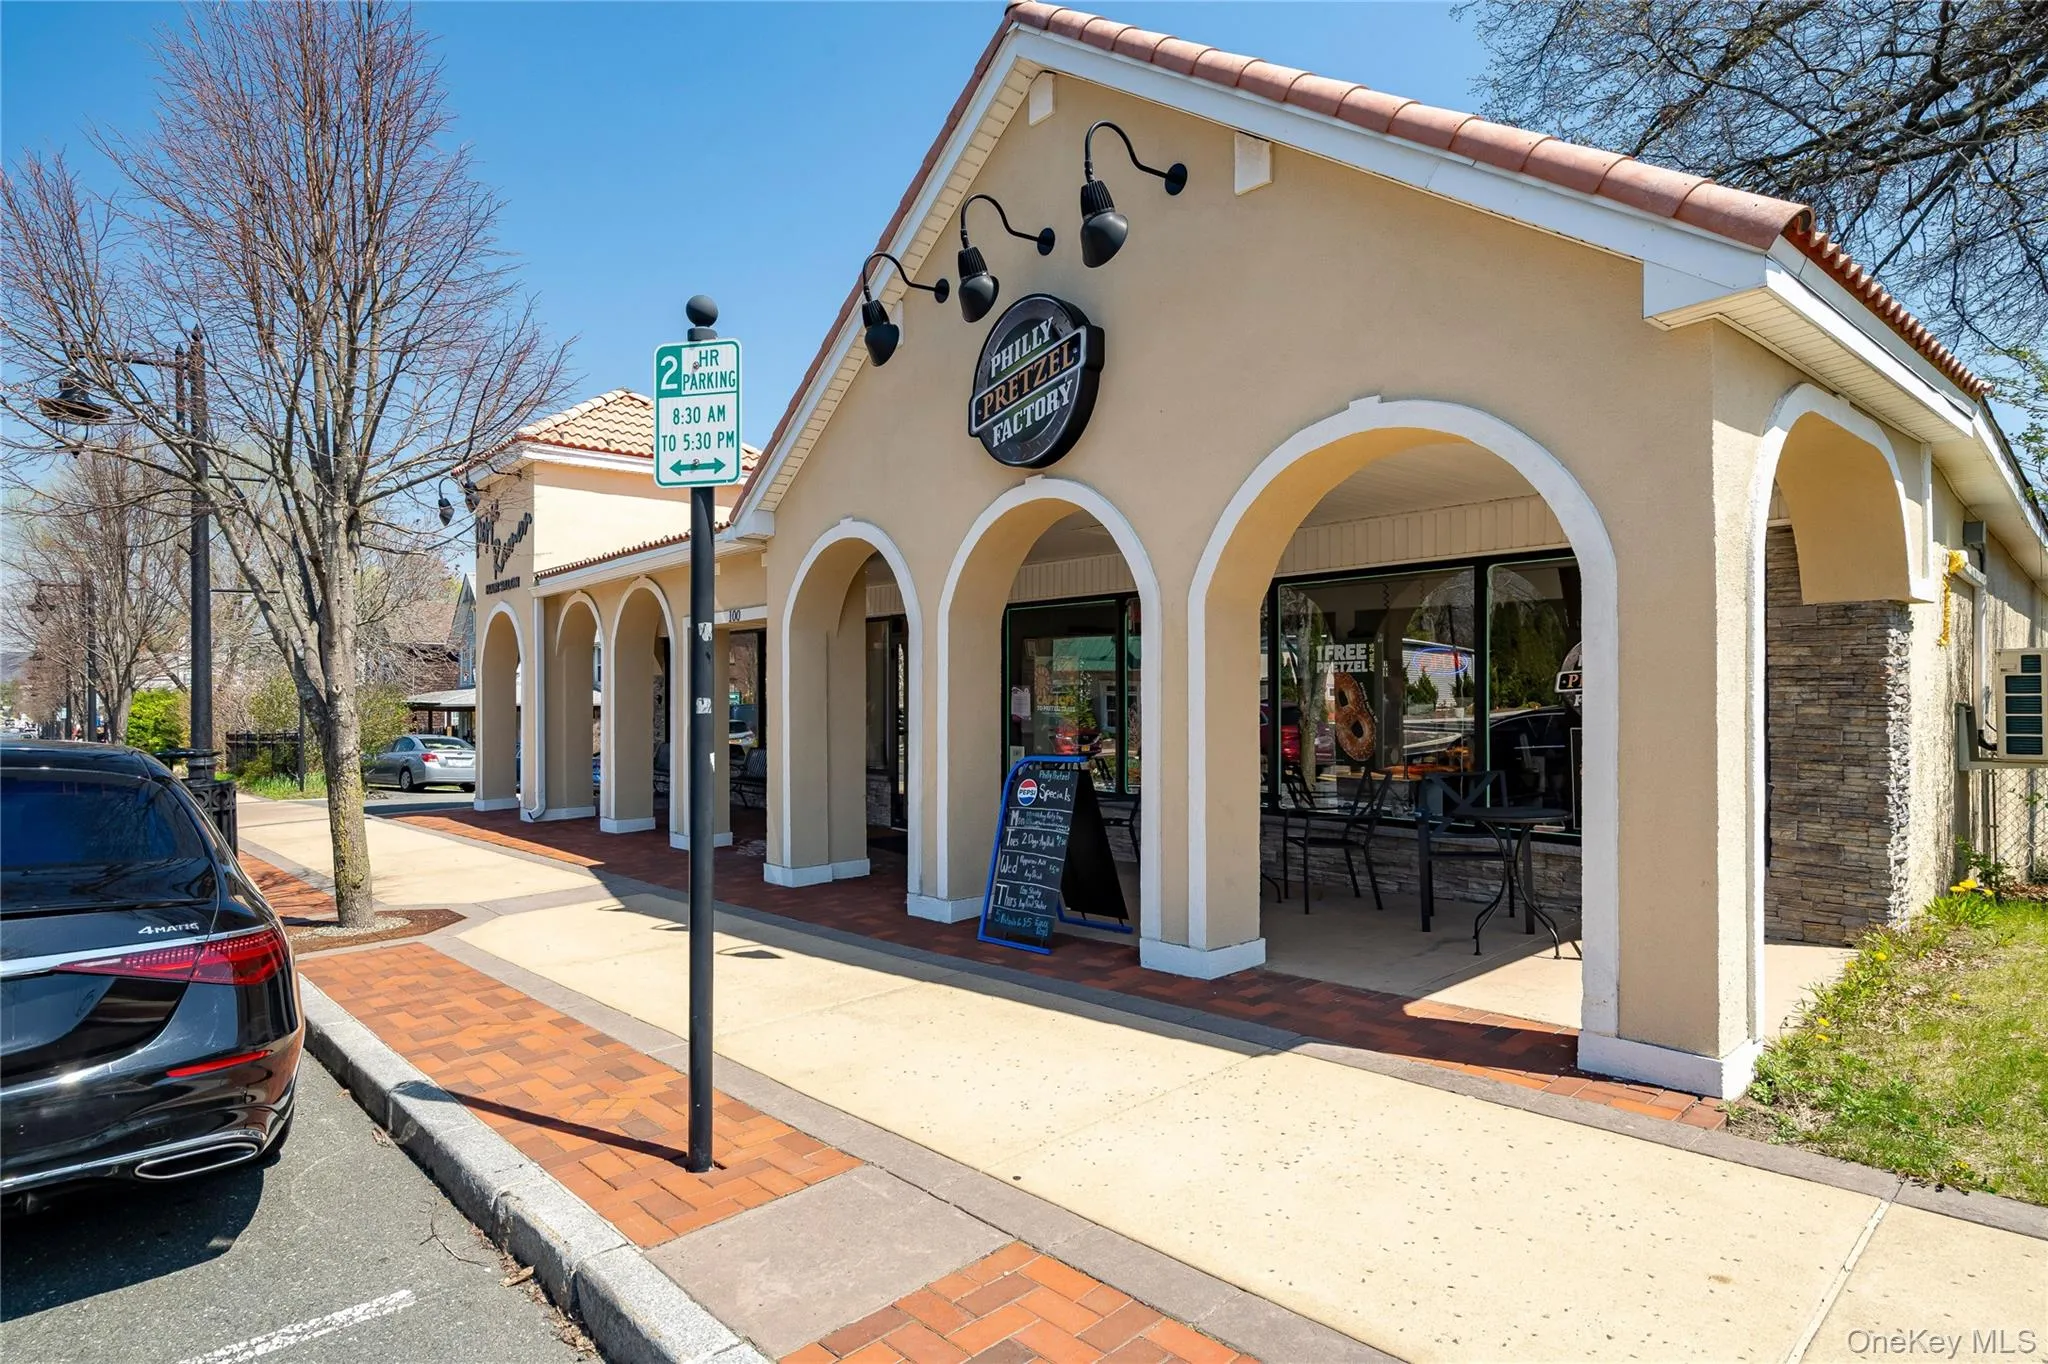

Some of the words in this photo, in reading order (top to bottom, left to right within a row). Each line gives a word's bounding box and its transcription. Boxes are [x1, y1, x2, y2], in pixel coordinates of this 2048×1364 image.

[991, 317, 1053, 378] PHILLY
[660, 355, 678, 390] 2
[699, 350, 719, 367] HR
[683, 370, 736, 391] PARKING
[983, 341, 1074, 420] PRETZEL
[673, 406, 700, 425] 8:30
[708, 405, 726, 423] AM
[993, 377, 1073, 447] FACTORY
[662, 435, 676, 452] TO
[684, 432, 711, 451] 5:30
[718, 431, 735, 448] PM
[729, 610, 741, 623] 100
[1324, 643, 1367, 661] FREE
[1316, 661, 1368, 673] PRETZEL
[1039, 783, 1071, 802] Specials
[1000, 854, 1019, 874] Wed
[138, 922, 200, 935] 4MATIC
